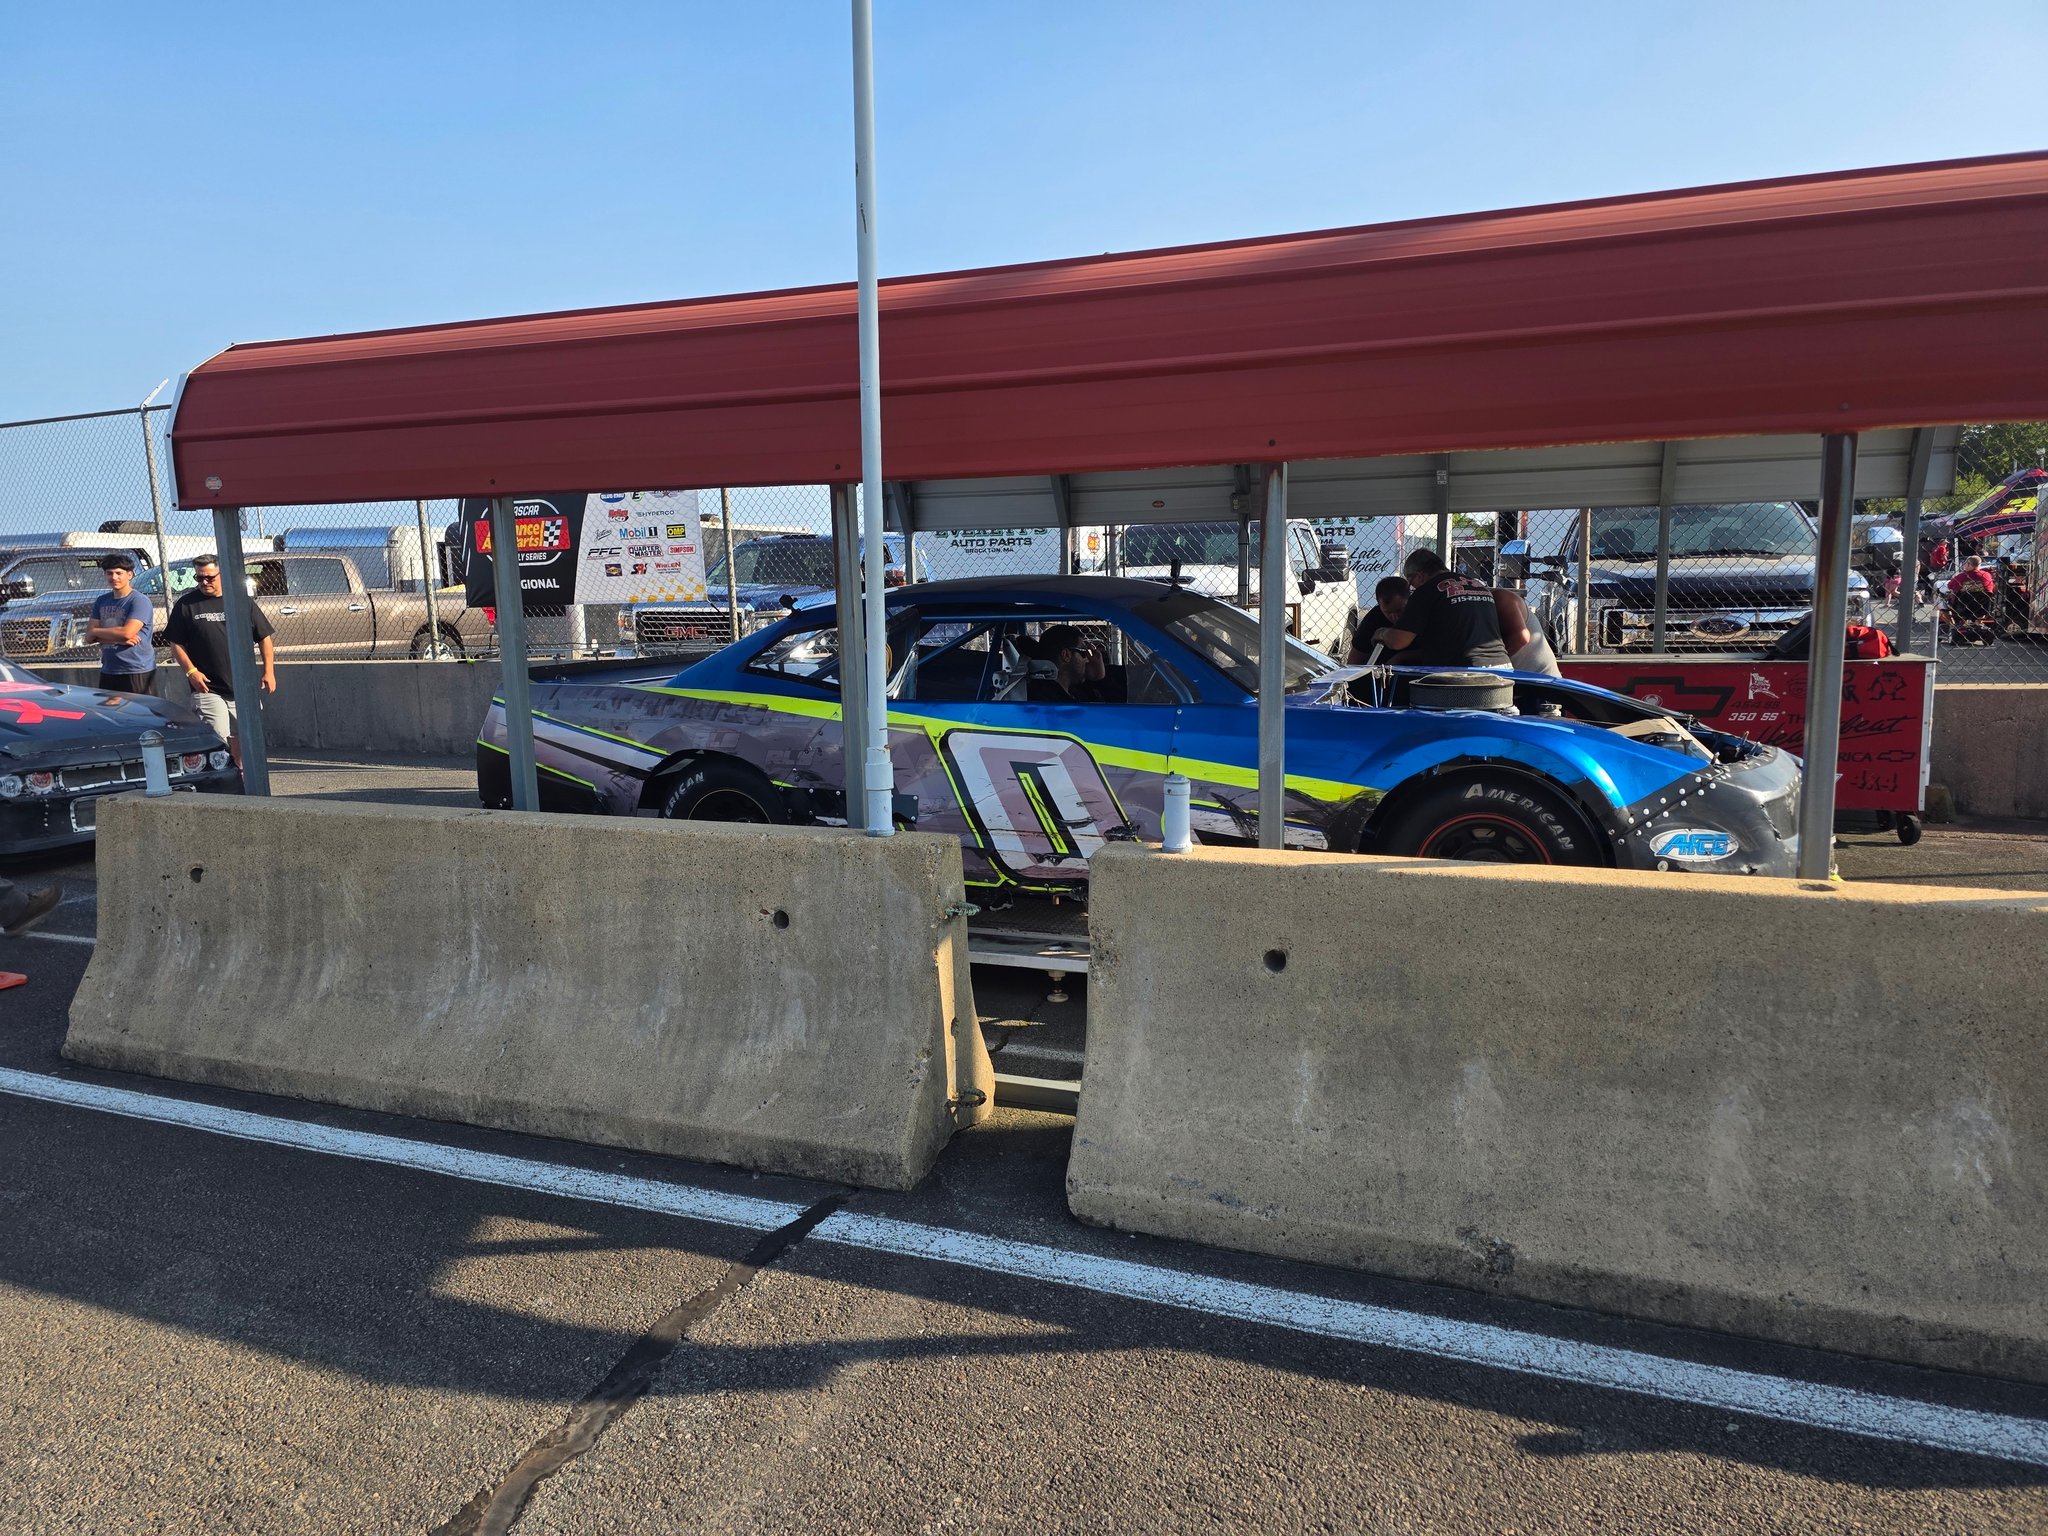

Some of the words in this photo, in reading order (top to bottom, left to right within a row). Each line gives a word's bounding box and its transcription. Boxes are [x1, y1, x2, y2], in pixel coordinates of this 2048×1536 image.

[513, 505, 540, 516] ASCAR
[619, 527, 646, 539] Mobil
[667, 527, 685, 536] OMP
[1315, 527, 1355, 536] ARTS
[516, 534, 539, 548] arts
[951, 539, 985, 547] AUTO
[989, 537, 1032, 546] PARTS
[526, 552, 547, 561] SERIES
[588, 547, 623, 556] PFC
[1350, 547, 1380, 559] Late
[520, 578, 560, 589] GIONAL
[664, 626, 707, 638] GMC
[1729, 712, 1755, 721] 350
[1760, 712, 1779, 721] SS
[1788, 714, 1806, 724] TH
[1656, 833, 1730, 856] AFCO
